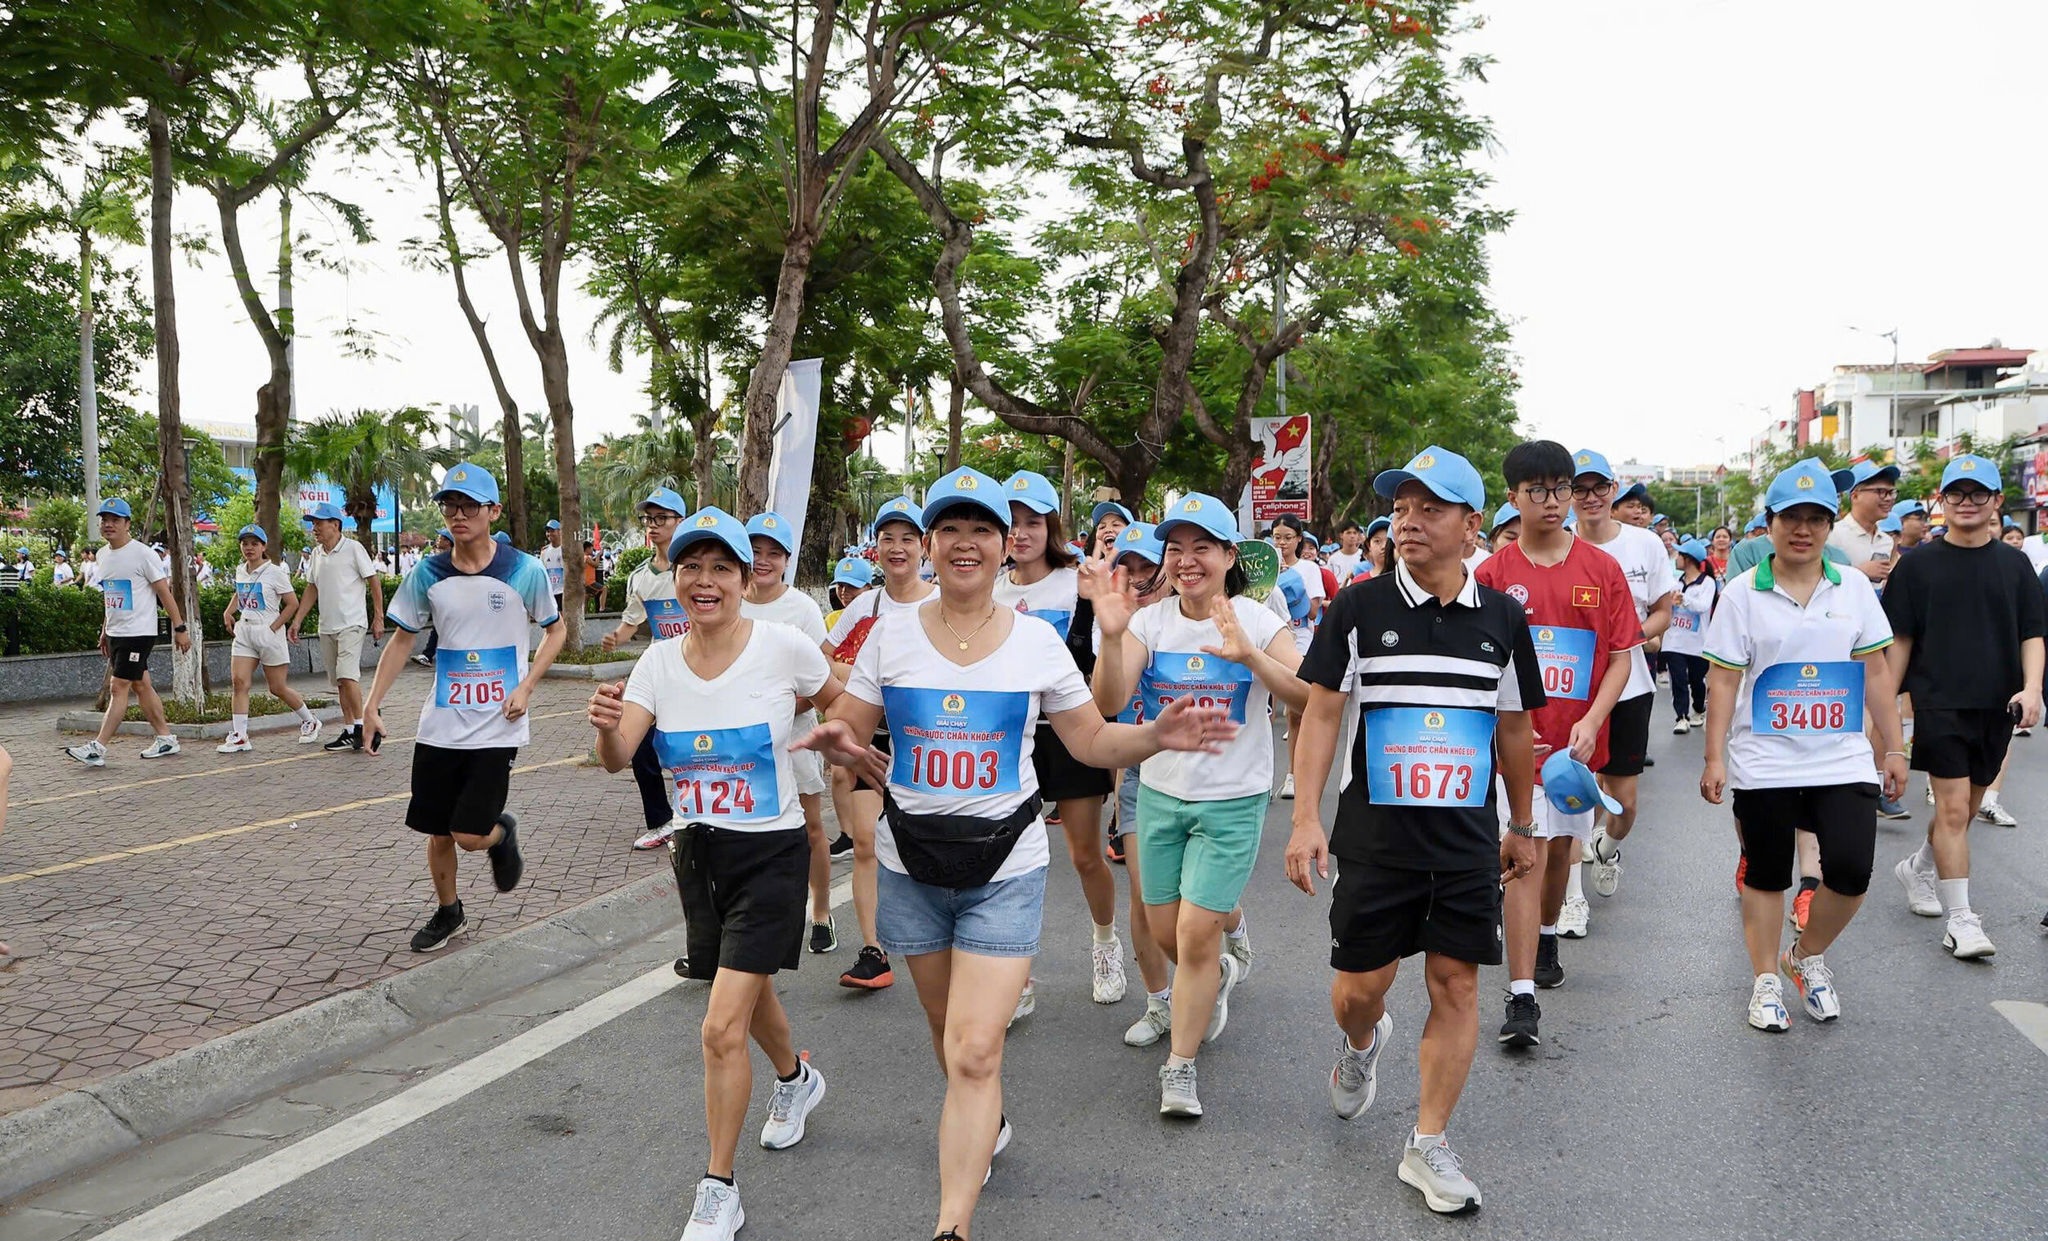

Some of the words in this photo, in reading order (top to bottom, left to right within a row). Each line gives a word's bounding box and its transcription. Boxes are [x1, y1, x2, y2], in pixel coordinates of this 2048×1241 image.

[448, 680, 506, 705] 2105
[1771, 702, 1845, 730] 3408
[911, 745, 1000, 790] 1003
[1389, 762, 1473, 800] 1673
[676, 778, 755, 814] 2124
